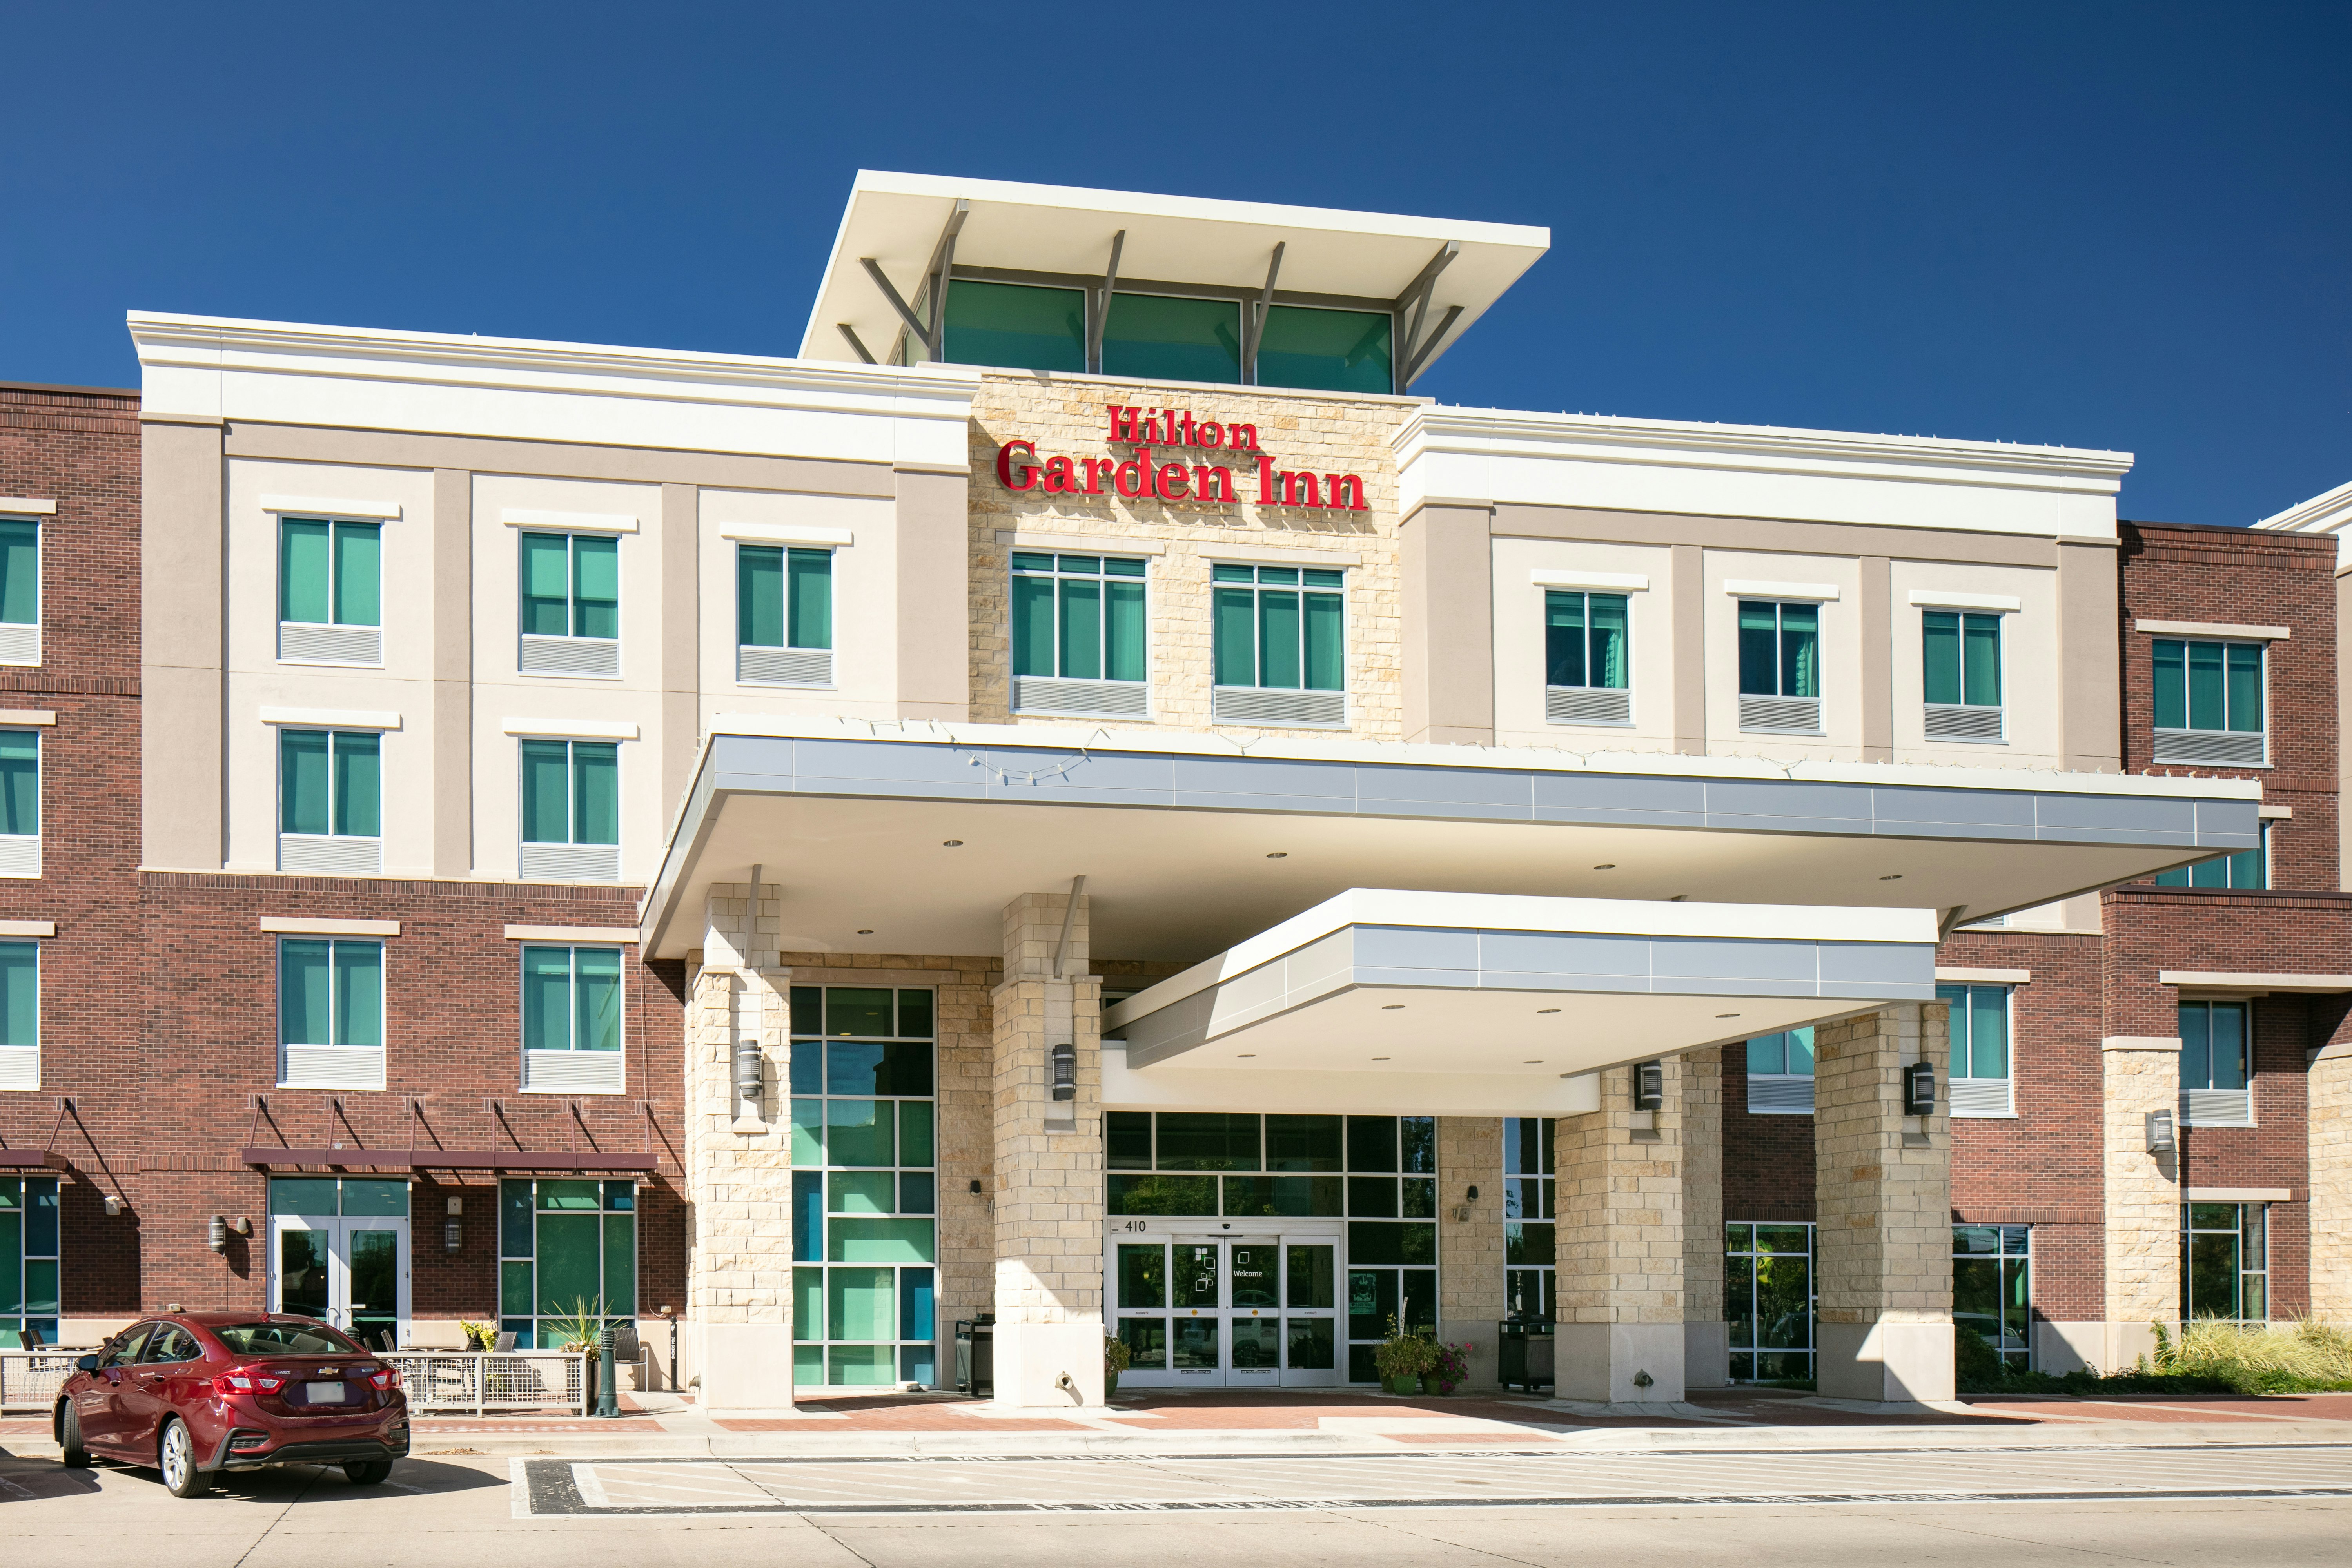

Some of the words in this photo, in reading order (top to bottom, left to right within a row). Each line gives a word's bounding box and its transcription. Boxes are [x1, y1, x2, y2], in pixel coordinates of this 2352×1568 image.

[1106, 405, 1260, 451] Hilton
[997, 439, 1238, 503] Garden
[1254, 455, 1368, 511] Inn
[1125, 1220, 1146, 1232] 410
